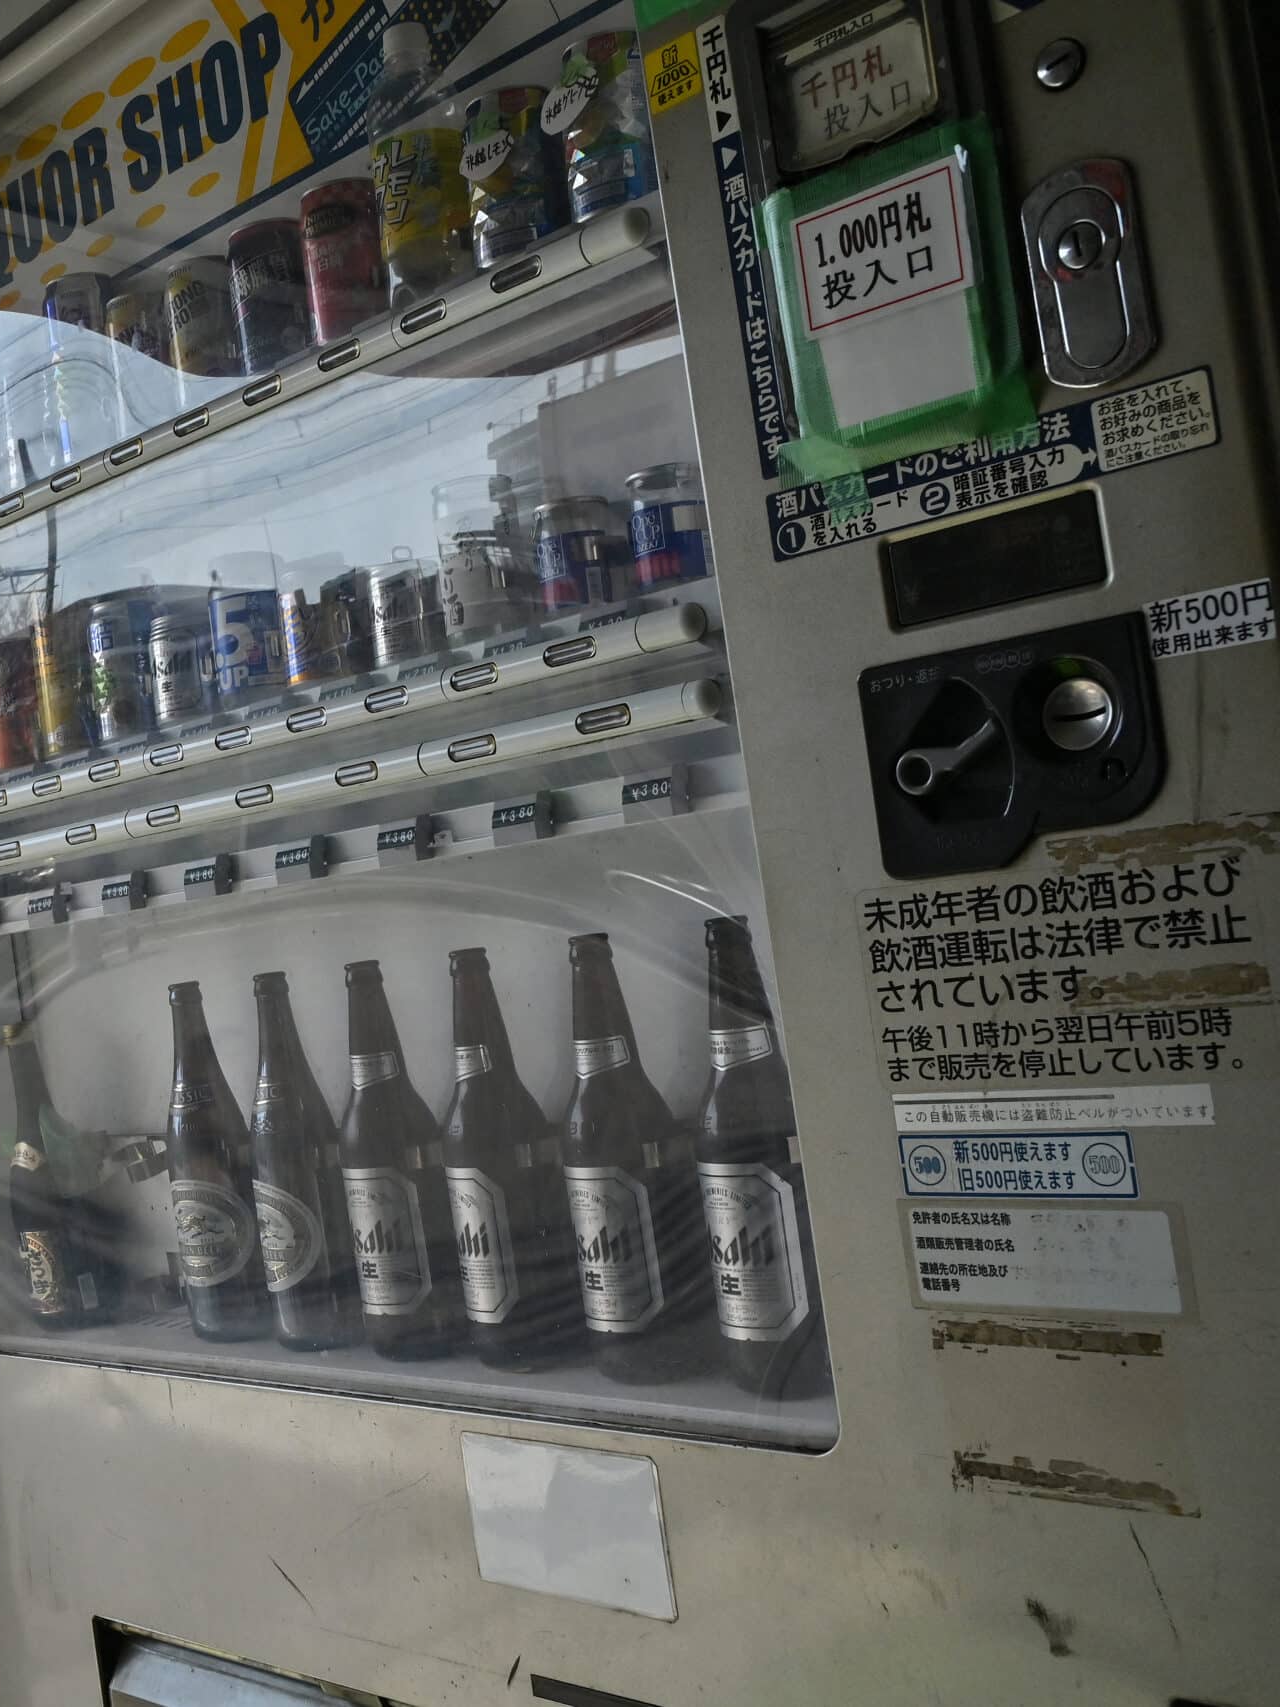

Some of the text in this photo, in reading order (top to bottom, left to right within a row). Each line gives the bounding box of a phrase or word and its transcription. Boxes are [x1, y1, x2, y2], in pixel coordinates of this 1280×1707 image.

[657, 64, 690, 90] 1000
[702, 25, 732, 104] 千円札
[800, 44, 892, 108] 千円札
[121, 12, 282, 192] SHOP
[658, 80, 693, 106] 使えます
[823, 80, 911, 139] 投入口
[387, 140, 417, 226] レモン
[821, 245, 934, 310] 投入口
[723, 174, 787, 459] 酒パスカードはこちらです
[1098, 380, 1191, 416] お金を入れて、
[1100, 391, 1201, 431] お好みの商品を
[1103, 407, 1211, 446] お求めください。
[953, 447, 1064, 491] 暗証番号入力
[955, 470, 1049, 511] 表示を確認
[813, 516, 877, 546] を入れる
[1149, 581, 1273, 634] 新500円
[1152, 617, 1273, 657] 使用出来ます
[631, 781, 668, 800] ¥380
[500, 806, 533, 823] ¥380
[864, 857, 1241, 932] 未成年者の飲酒および
[869, 905, 1252, 974] 飲酒運転は法律で禁止
[877, 965, 1104, 1013] されています。
[883, 1007, 1233, 1052] 午後11時から翌日午前5時
[887, 1043, 1245, 1082] まで販売を停止しています。
[953, 1140, 1072, 1164] 新500円使えます
[1088, 1154, 1120, 1175] 500
[958, 1168, 1076, 1192] 旧500円使えます
[912, 1211, 1012, 1226] 免許者の氏名又は名称
[919, 1261, 1008, 1278] 連絡先の所在地及び
[921, 1277, 961, 1292] 電話番号
